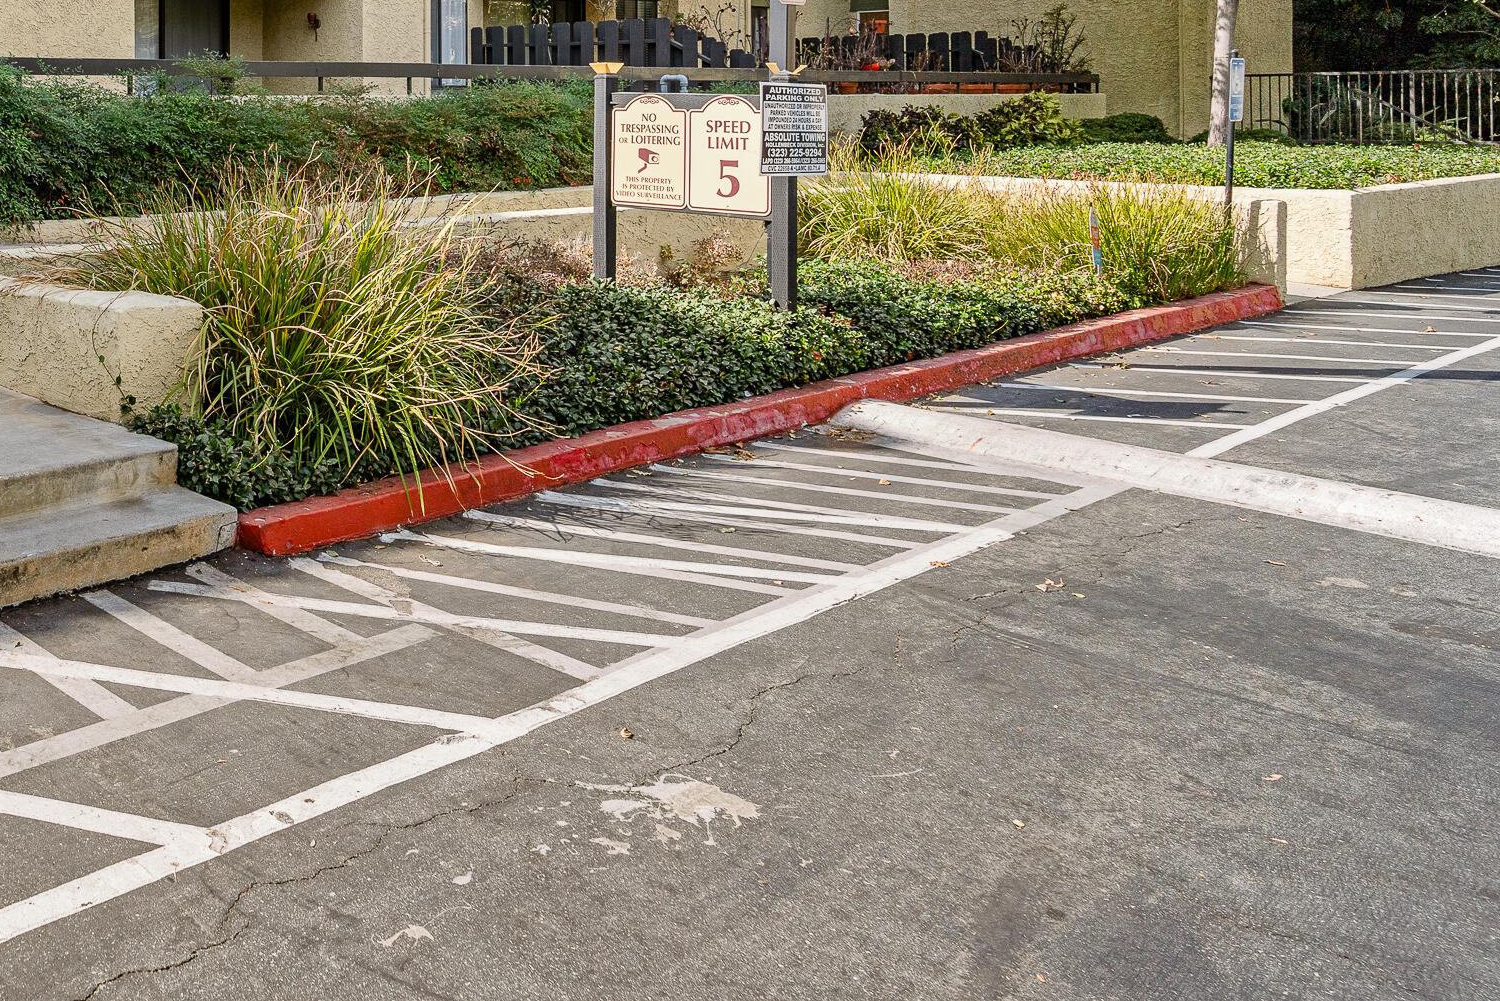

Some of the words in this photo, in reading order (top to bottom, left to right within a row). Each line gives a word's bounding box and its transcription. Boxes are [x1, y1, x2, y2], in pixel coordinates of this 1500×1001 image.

[770, 87, 820, 95] AUTHORIZED
[642, 113, 656, 122] NO
[621, 124, 679, 134] TRESPASSING
[706, 120, 751, 133] SPEED
[631, 135, 680, 145] LOITERING
[764, 133, 800, 141] ABSOLUTE
[801, 133, 825, 141] TOWING
[708, 136, 749, 150] LIMIT
[768, 148, 788, 157] (323)
[789, 148, 822, 157] 225-9294
[716, 160, 740, 197] 5
[637, 192, 682, 200] SURVEILLANCE
